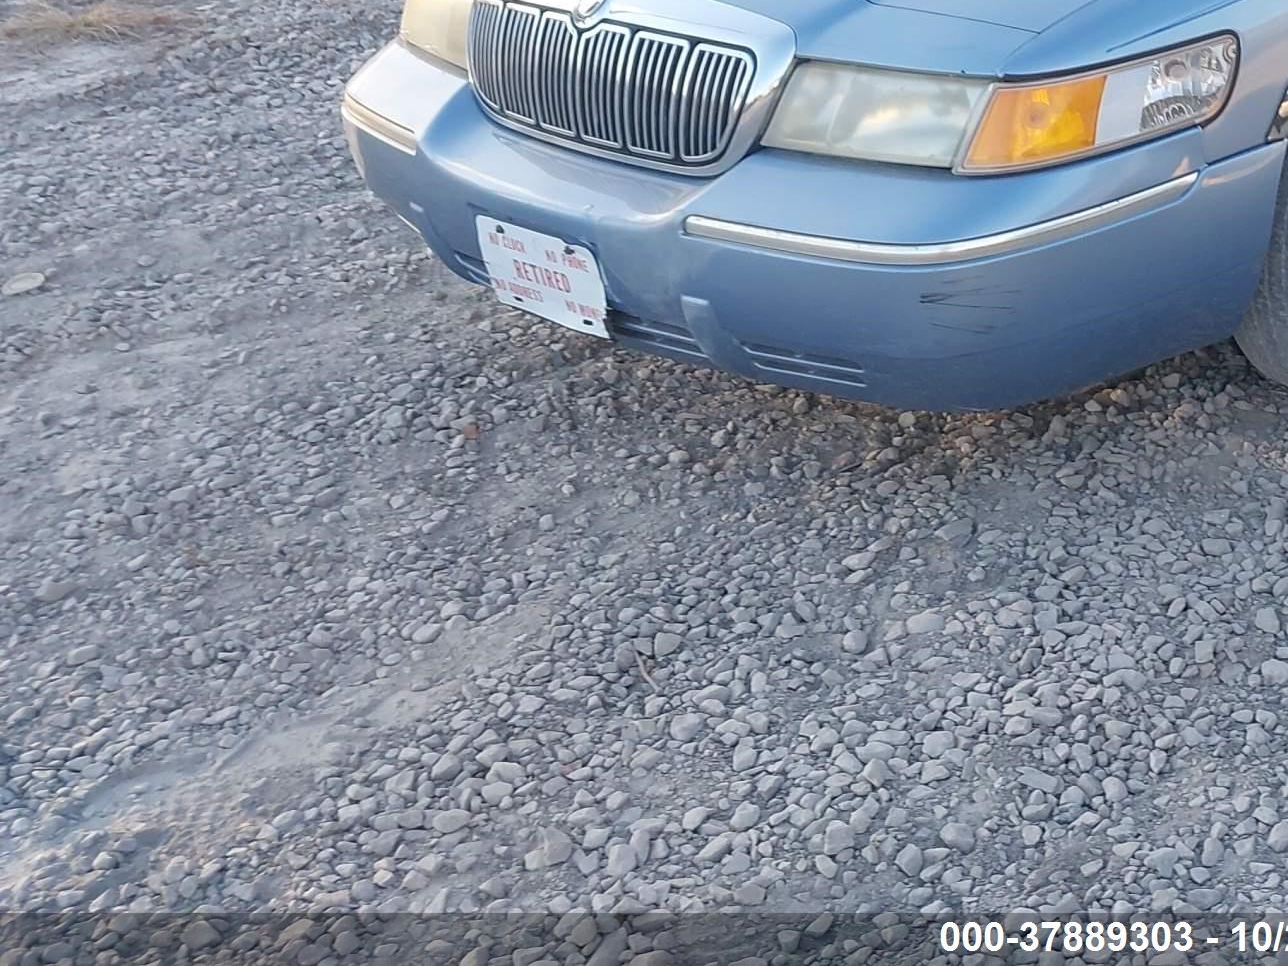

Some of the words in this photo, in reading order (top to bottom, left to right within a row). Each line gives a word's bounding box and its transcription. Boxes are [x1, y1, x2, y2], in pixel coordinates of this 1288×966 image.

[488, 232, 499, 245] NO
[502, 235, 526, 253] CLOCK
[545, 250, 557, 263] NO
[562, 253, 589, 273] PHONE
[512, 259, 571, 293] RETIRED
[495, 278, 507, 291] NO
[508, 281, 544, 303] ADDRESS
[564, 300, 577, 313] NO
